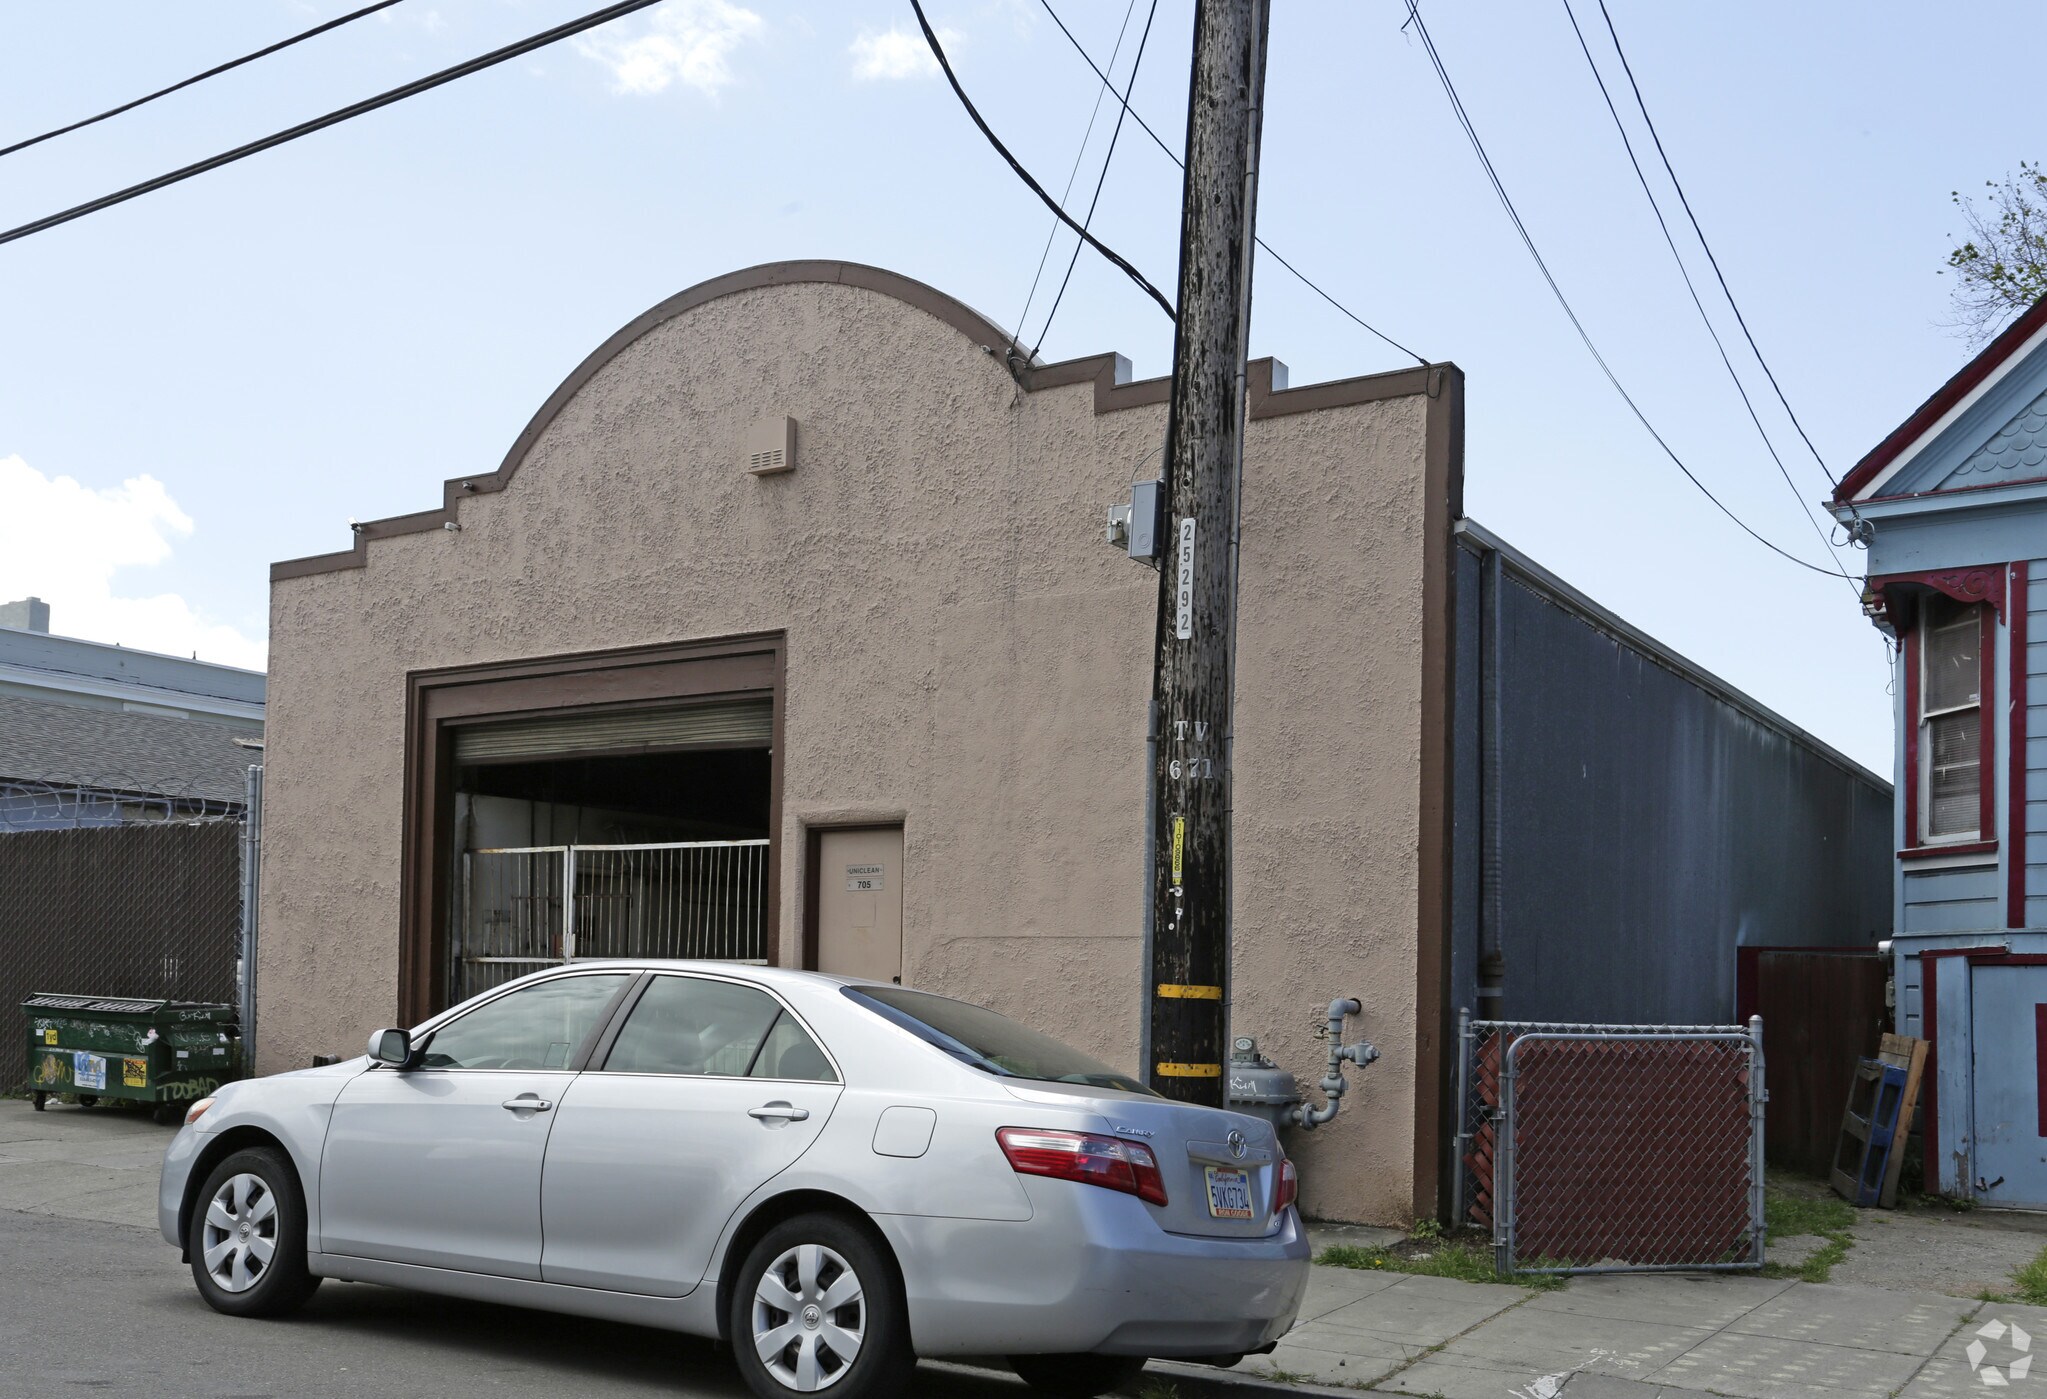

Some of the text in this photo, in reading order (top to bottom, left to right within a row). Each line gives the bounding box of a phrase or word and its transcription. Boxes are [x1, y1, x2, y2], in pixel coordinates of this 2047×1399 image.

[1180, 523, 1193, 631] 25292
[1174, 719, 1209, 742] TV
[1169, 757, 1215, 780] 671
[849, 867, 880, 875] UNICLEAN
[857, 880, 872, 889] 705
[1211, 1185, 1250, 1209] 5VKG734
